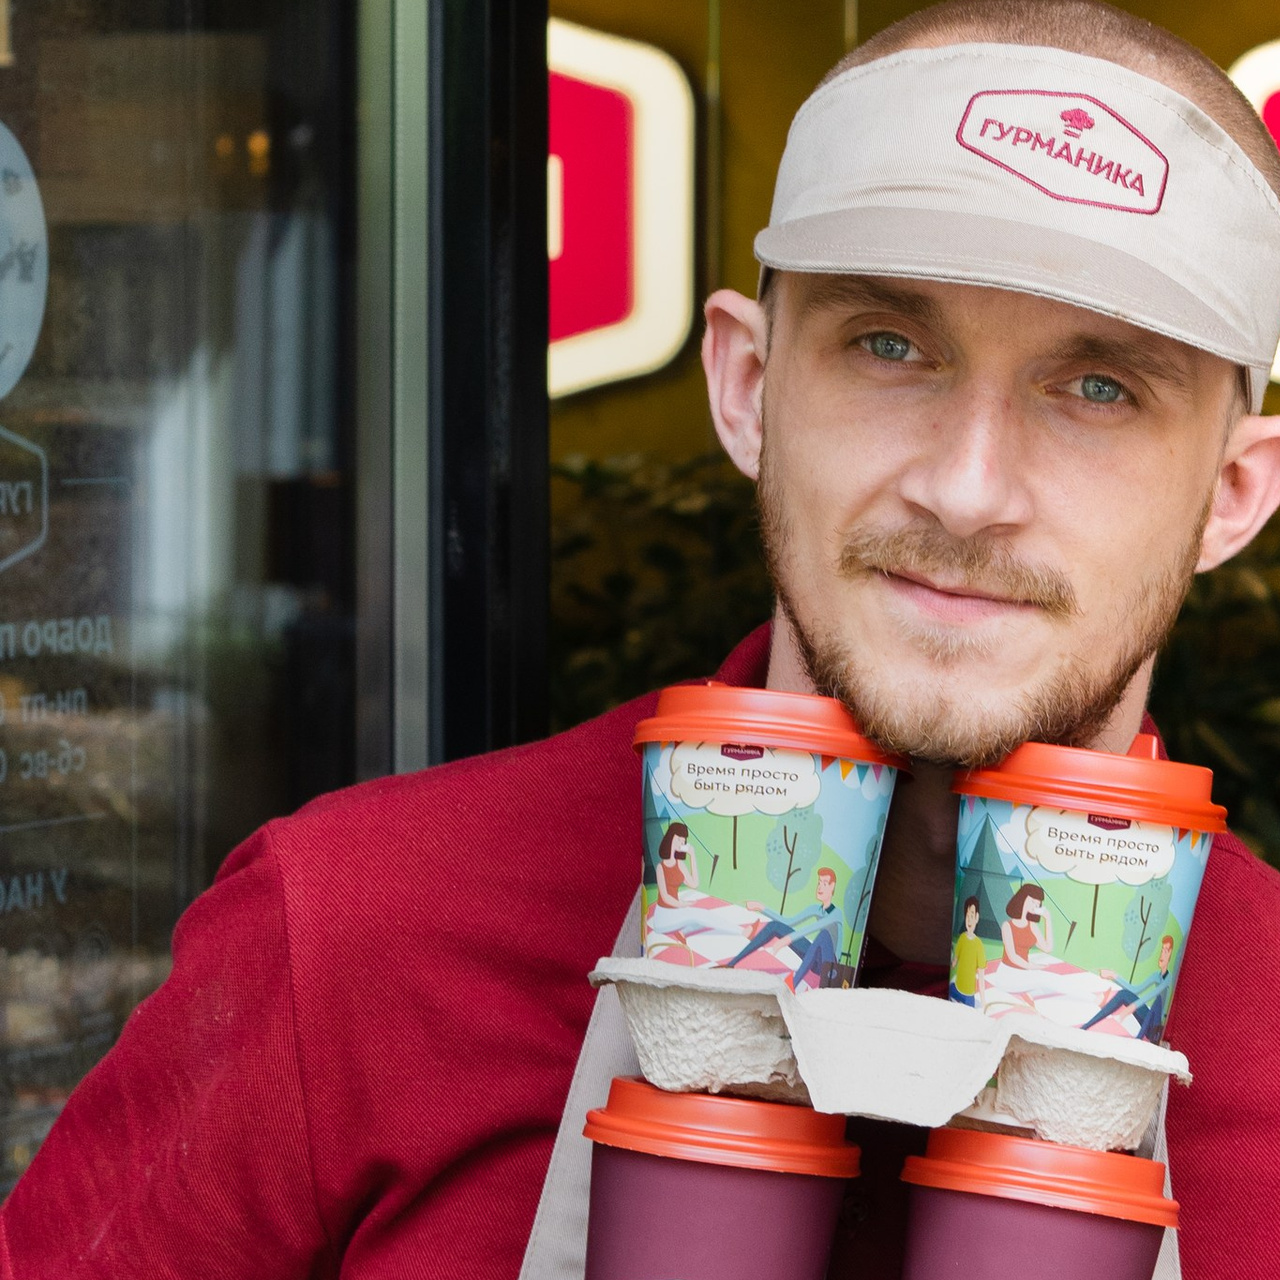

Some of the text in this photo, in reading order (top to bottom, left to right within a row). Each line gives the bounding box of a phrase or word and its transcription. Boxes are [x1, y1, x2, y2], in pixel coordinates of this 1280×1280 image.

[978, 117, 1147, 198] ГУРМАНИКА
[687, 763, 799, 782] Время просто
[694, 779, 787, 796] быть рядом
[1047, 826, 1160, 854] Время просто
[1054, 844, 1149, 868] быть рядом
